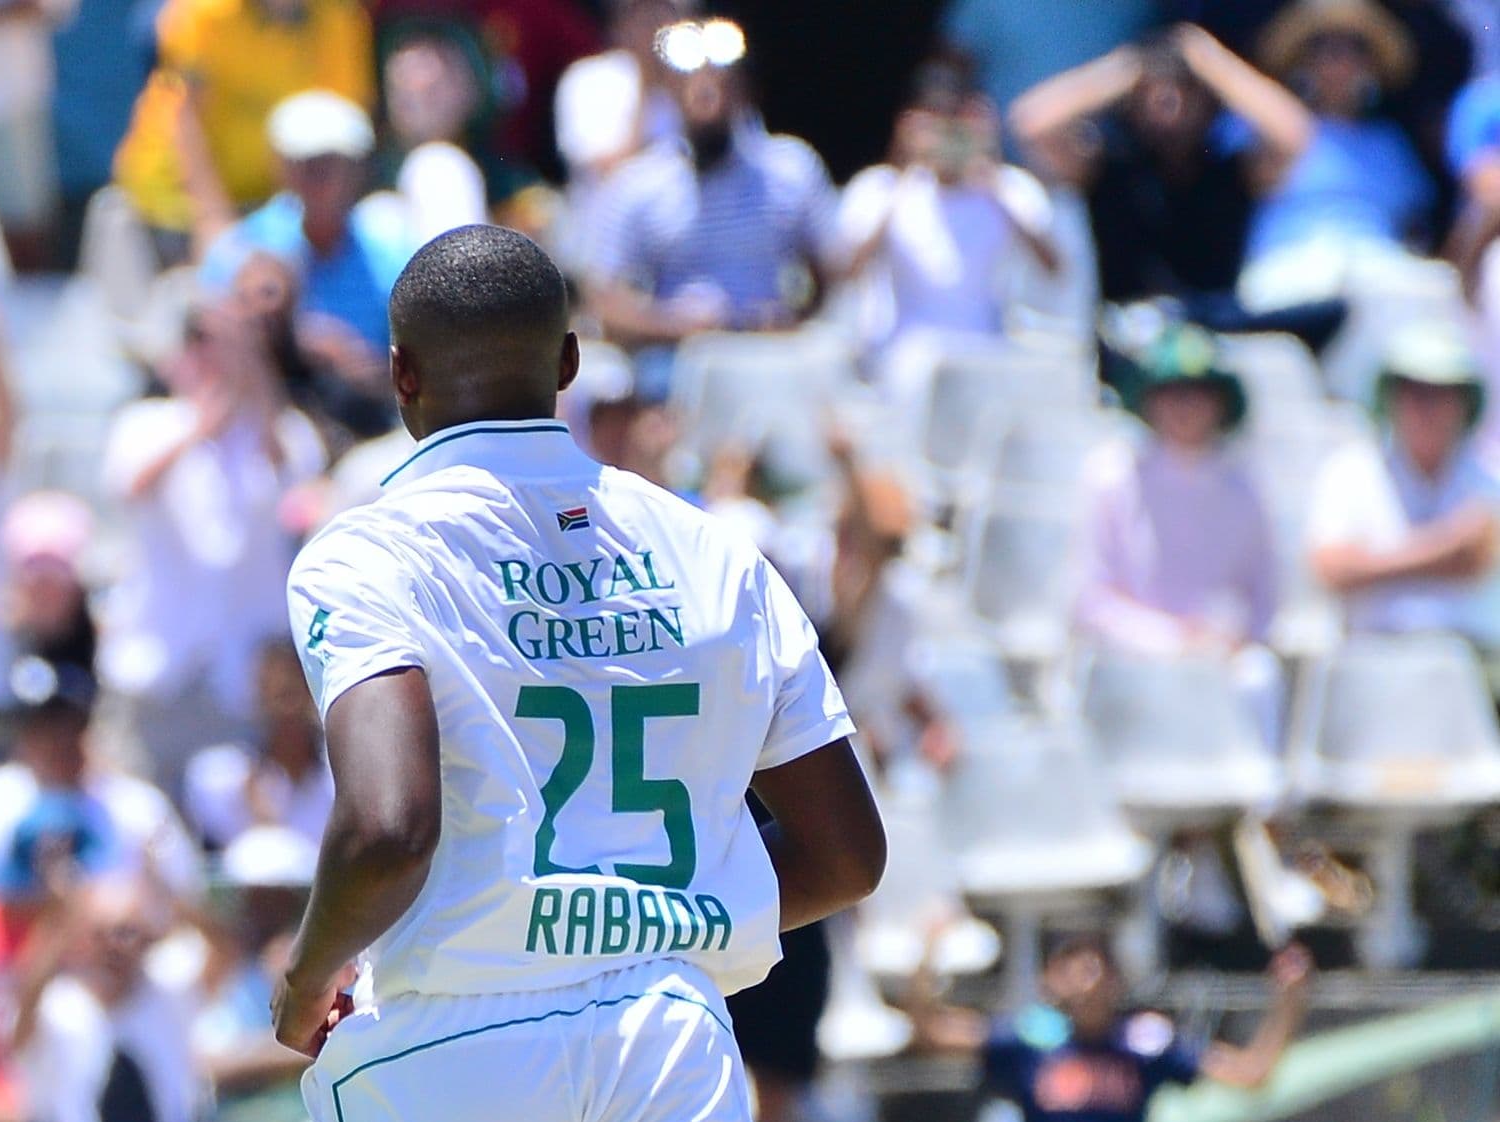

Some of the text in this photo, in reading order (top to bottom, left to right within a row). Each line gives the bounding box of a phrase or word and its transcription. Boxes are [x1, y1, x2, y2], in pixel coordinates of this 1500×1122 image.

[495, 550, 675, 604] ROYAL
[508, 607, 687, 661] GREEN
[514, 683, 700, 890] 25
[525, 887, 733, 955] RABADA
